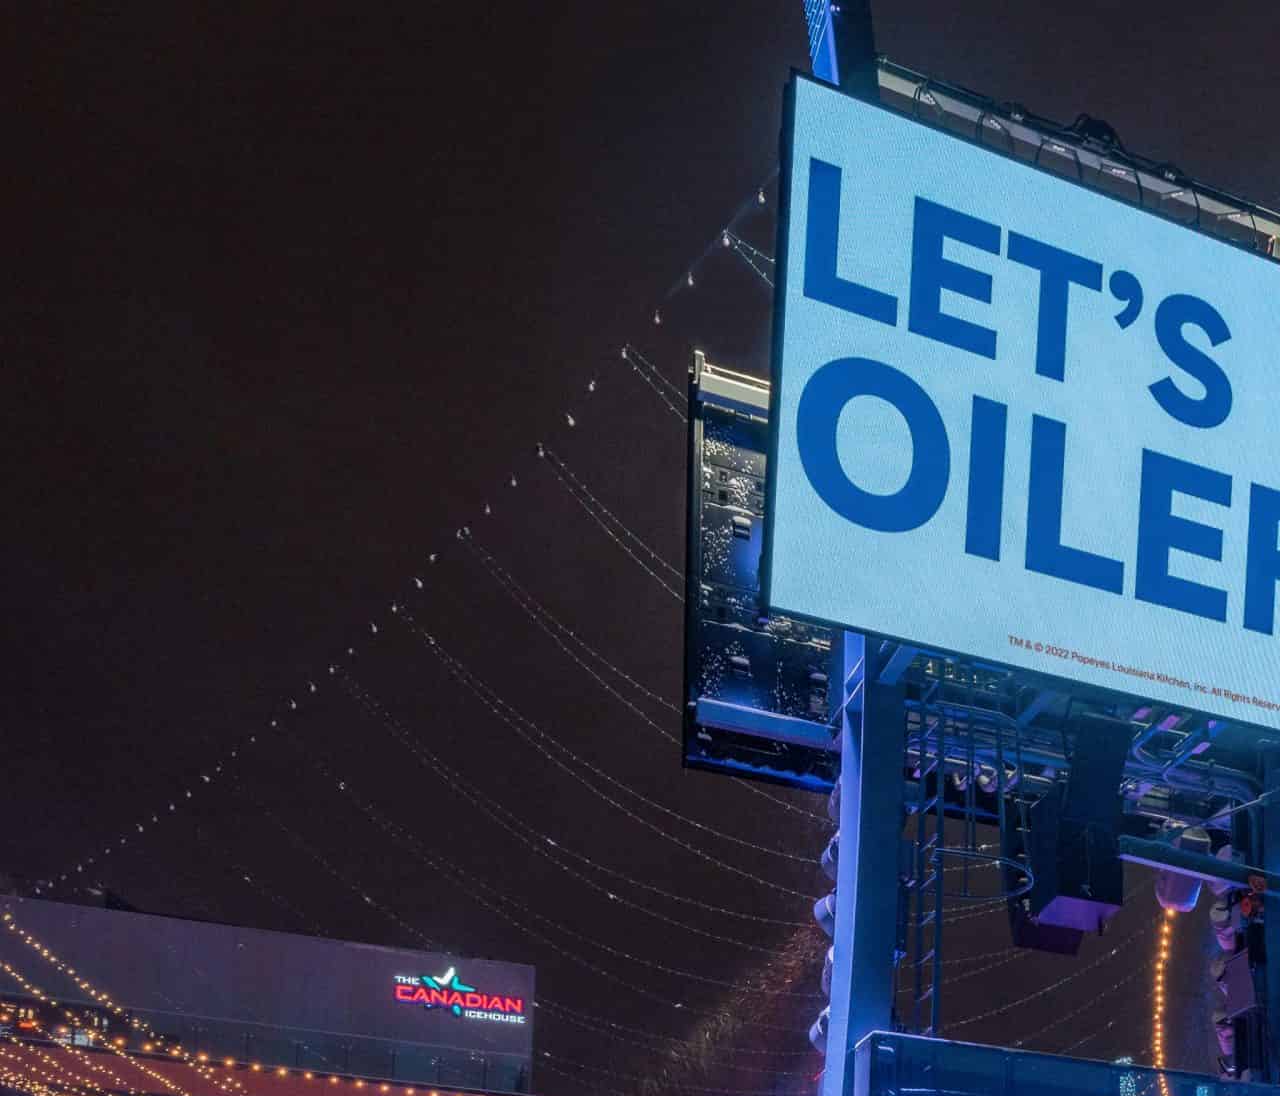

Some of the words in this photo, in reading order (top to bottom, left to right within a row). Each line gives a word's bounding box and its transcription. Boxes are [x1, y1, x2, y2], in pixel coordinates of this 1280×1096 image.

[803, 155, 1233, 429] LET'S
[1008, 634, 1024, 648] TM
[1046, 645, 1069, 659] 2022
[1072, 651, 1110, 669] Popeyes
[394, 975, 420, 985] THE
[395, 983, 523, 1013] CANADIAN
[464, 1009, 526, 1024] ICEHOUSE
